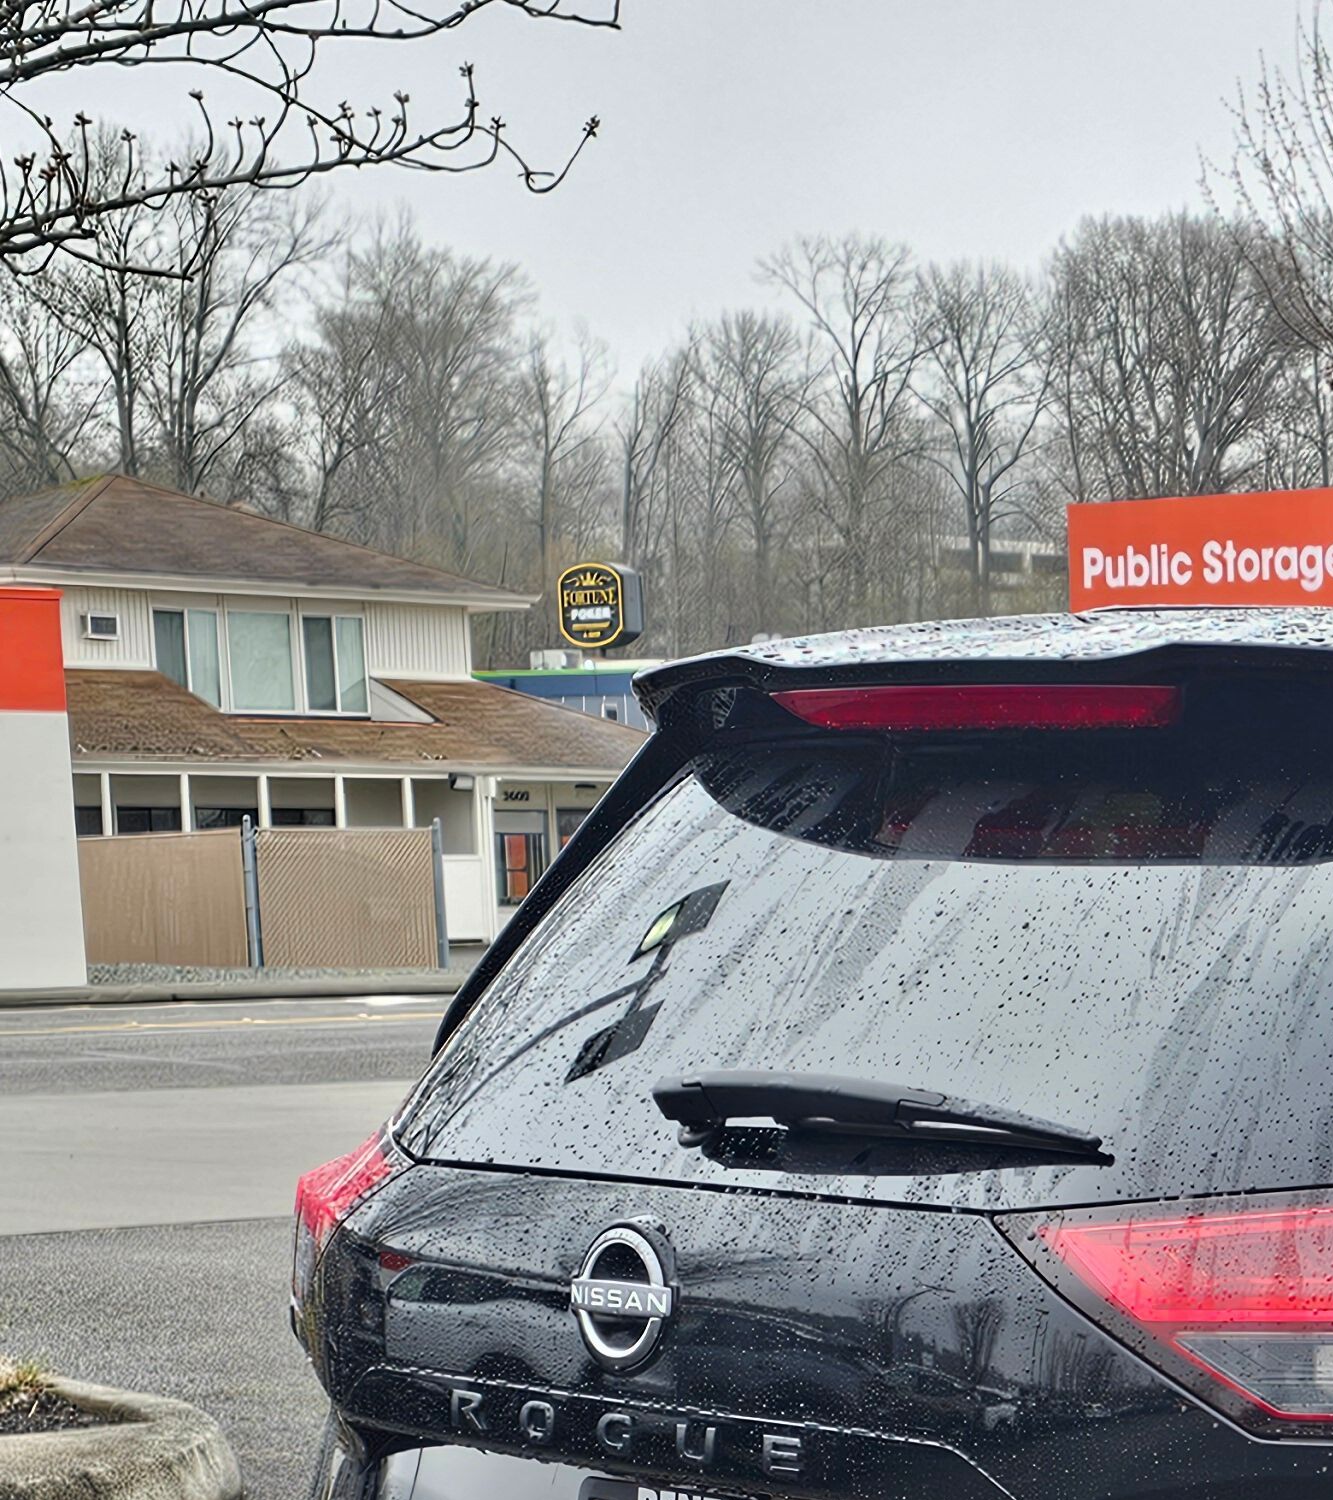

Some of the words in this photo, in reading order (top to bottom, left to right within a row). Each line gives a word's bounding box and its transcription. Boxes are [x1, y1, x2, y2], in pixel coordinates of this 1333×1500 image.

[1082, 543, 1193, 589] Public
[571, 1283, 667, 1313] NISSAN
[449, 1388, 801, 1475] ROGUE
